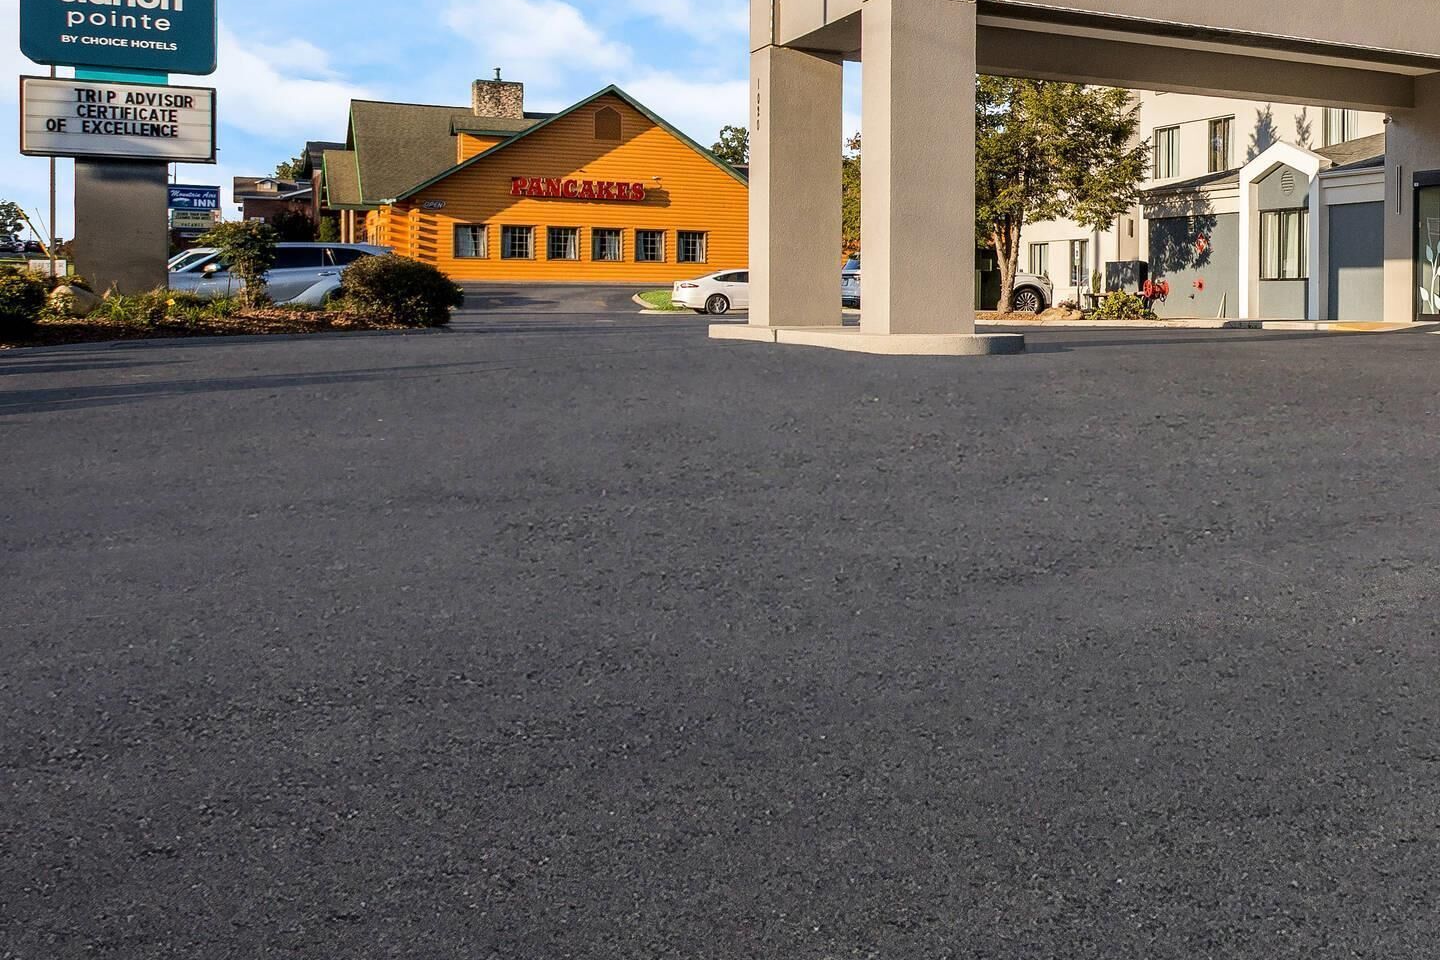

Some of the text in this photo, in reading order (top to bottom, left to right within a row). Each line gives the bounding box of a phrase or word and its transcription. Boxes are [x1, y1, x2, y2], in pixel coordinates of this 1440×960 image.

[67, 10, 171, 31] pointe
[61, 35, 177, 51] BY CHOICE HOTELS
[74, 88, 193, 108] TRIP ADVISOR
[77, 105, 178, 123] CERTIFICATE
[46, 118, 178, 137] OF EXCELLENCE
[510, 176, 646, 201] PANCAKES
[193, 199, 216, 207] INN
[424, 201, 444, 209] OPEN
